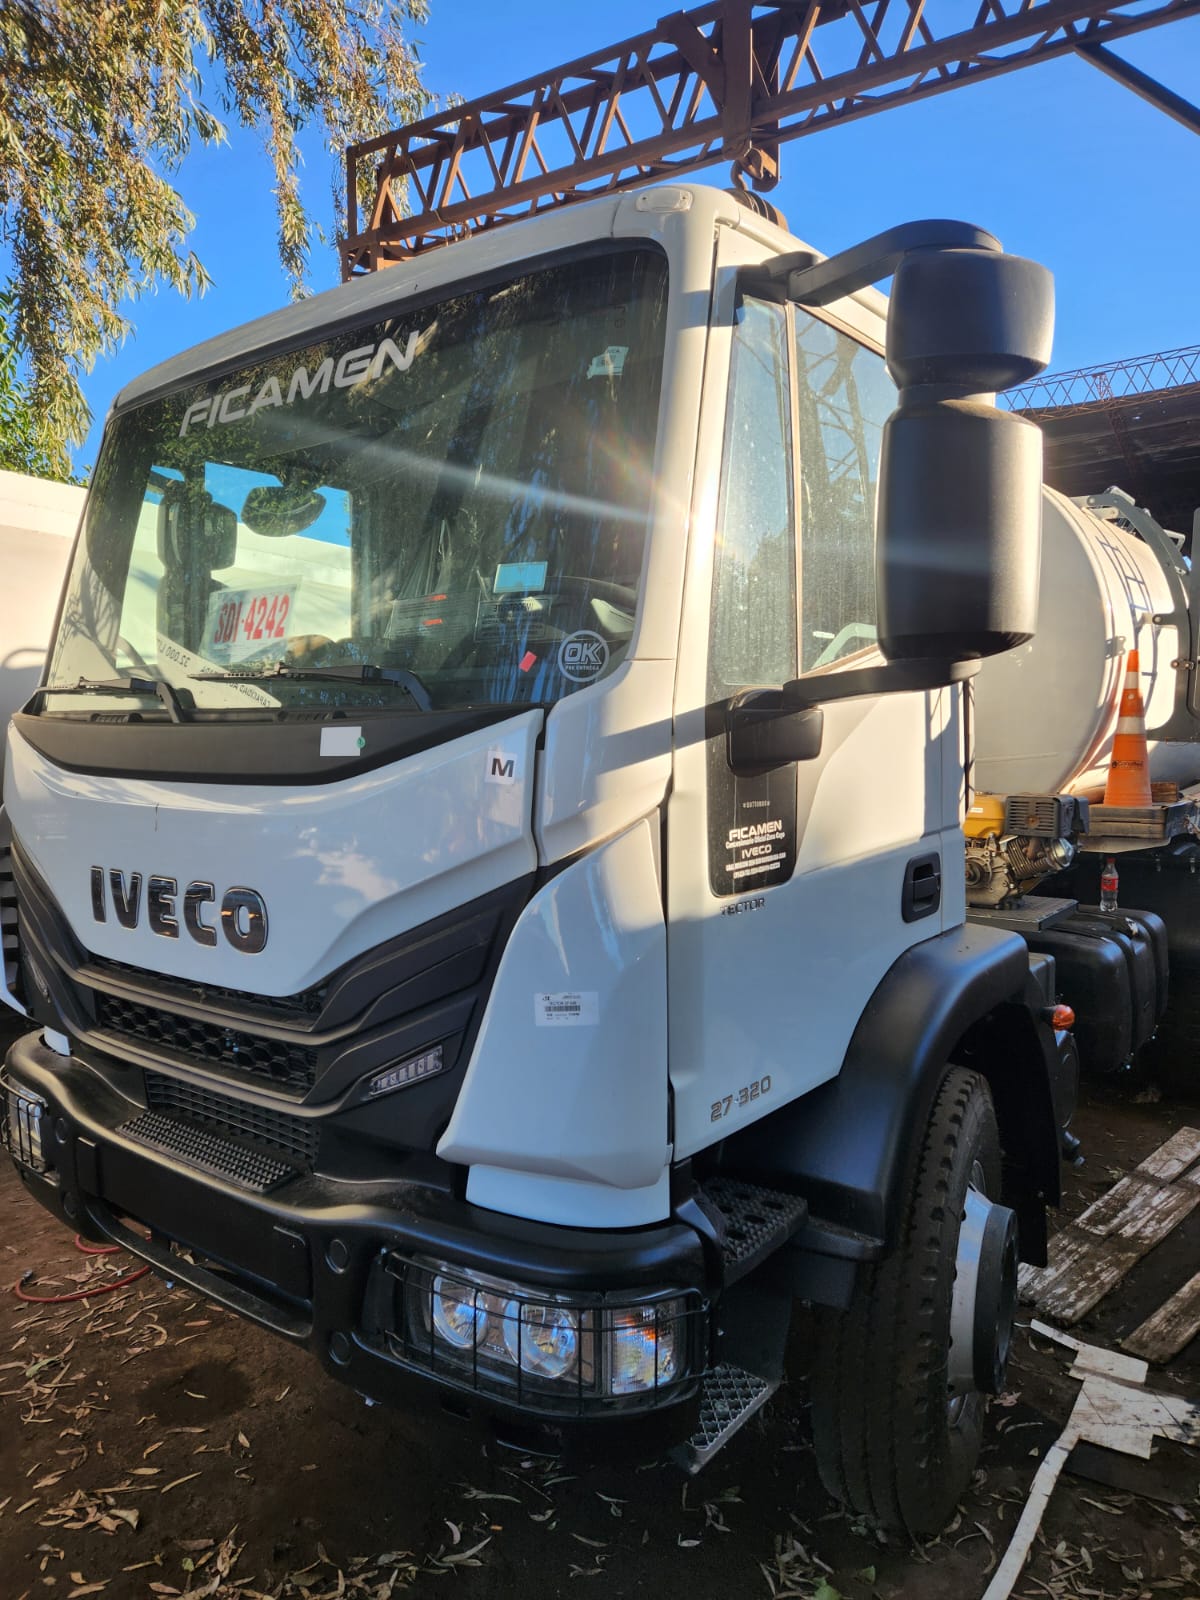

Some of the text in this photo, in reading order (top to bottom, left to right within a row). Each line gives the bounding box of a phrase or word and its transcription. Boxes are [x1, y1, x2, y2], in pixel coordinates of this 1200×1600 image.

[179, 331, 419, 437] FICAMEN
[565, 642, 602, 664] OK
[491, 757, 515, 777] M
[729, 820, 783, 841] FICAMEN
[741, 844, 772, 859] IVECO
[91, 865, 268, 955] IVECO
[720, 898, 765, 915] TECTOR
